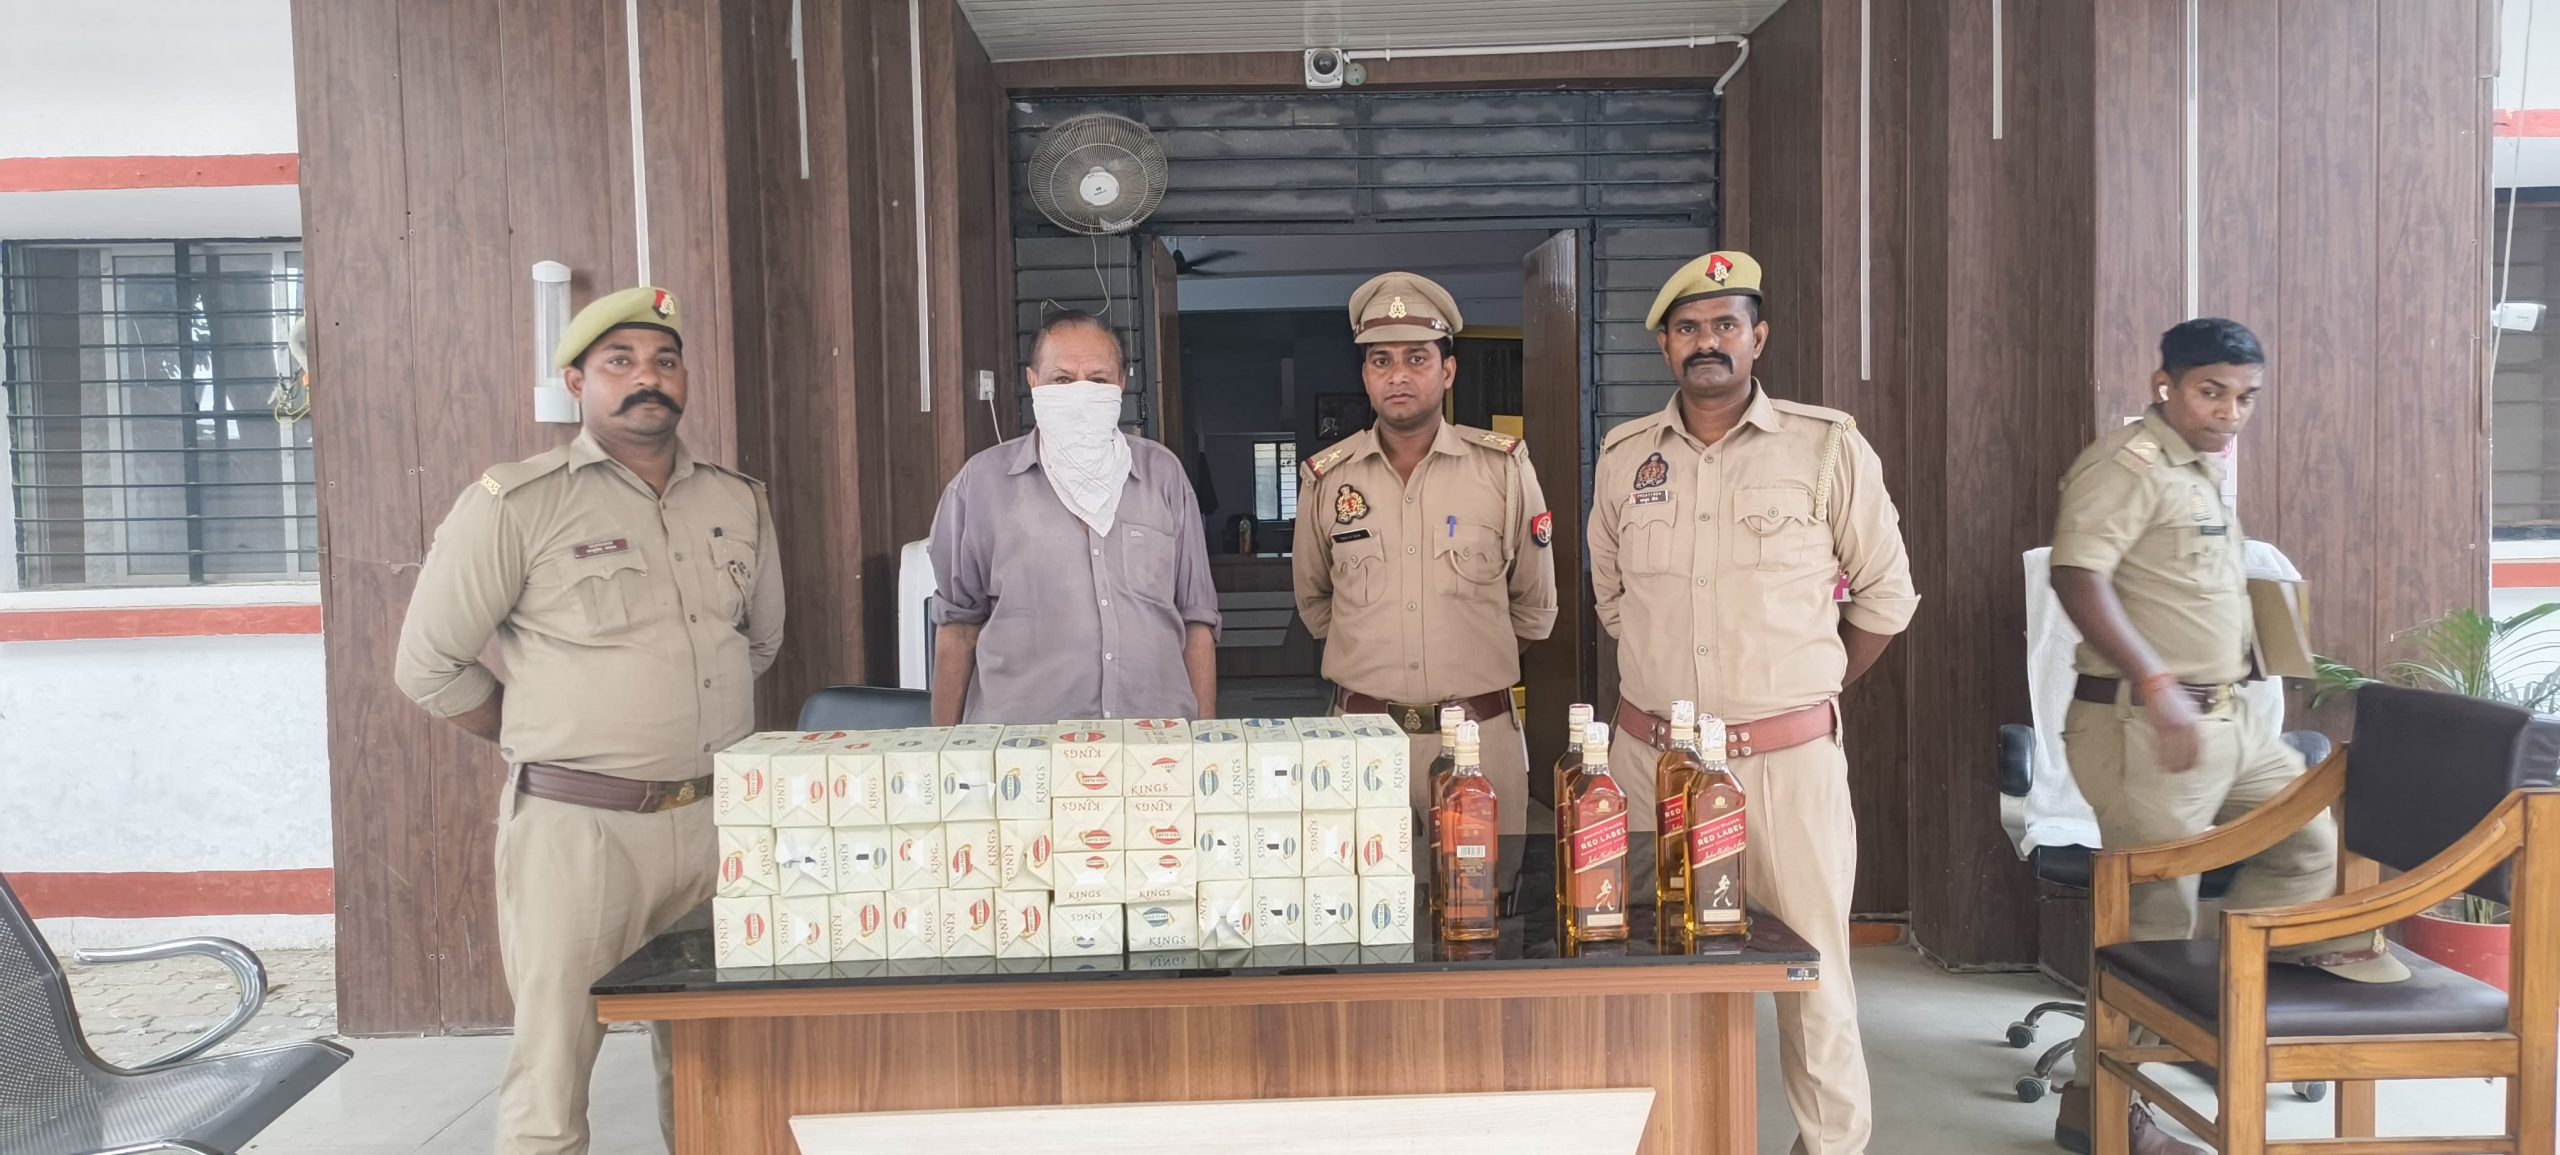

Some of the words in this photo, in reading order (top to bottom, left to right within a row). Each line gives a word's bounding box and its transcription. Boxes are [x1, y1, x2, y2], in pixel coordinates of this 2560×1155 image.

[1063, 746, 1102, 758] KINGS
[1036, 766, 1048, 803] KINGS
[1232, 758, 1245, 796] KINGS
[1247, 768, 1255, 800] KINGS
[1342, 753, 1354, 792] KINGS
[1394, 751, 1406, 788] KINGS
[718, 777, 729, 815] KINGS
[775, 777, 786, 810] KINGS
[869, 777, 880, 809] KINGS
[924, 773, 935, 805] KINGS
[1062, 799, 1100, 811] KINGS
[1131, 783, 1169, 796] KINGS
[1135, 800, 1173, 811] KINGS
[1665, 808, 1681, 818] RED
[988, 829, 999, 866] KINGS
[1233, 834, 1244, 866] KINGS
[1255, 827, 1265, 858] KINGS
[1308, 820, 1320, 852] KINGS
[1581, 839, 1598, 850] RED
[1600, 827, 1626, 842] LABEL
[1697, 834, 1715, 847] RED
[1717, 823, 1744, 839] LABEL
[757, 838, 772, 876] KINGS
[819, 845, 830, 878] KINGS
[839, 843, 850, 876] KINGS
[931, 842, 942, 874] KING
[1069, 890, 1101, 901] KINGS
[1139, 890, 1171, 900] KINGS
[1398, 890, 1408, 927] KINGS
[924, 912, 936, 942] KINGS
[999, 909, 1010, 946] KINGS
[1071, 910, 1103, 922] KINGS
[1256, 896, 1268, 927] KINGS
[718, 918, 729, 956] KINGS
[778, 912, 789, 945] KINGS
[1149, 936, 1186, 947] KINGS
